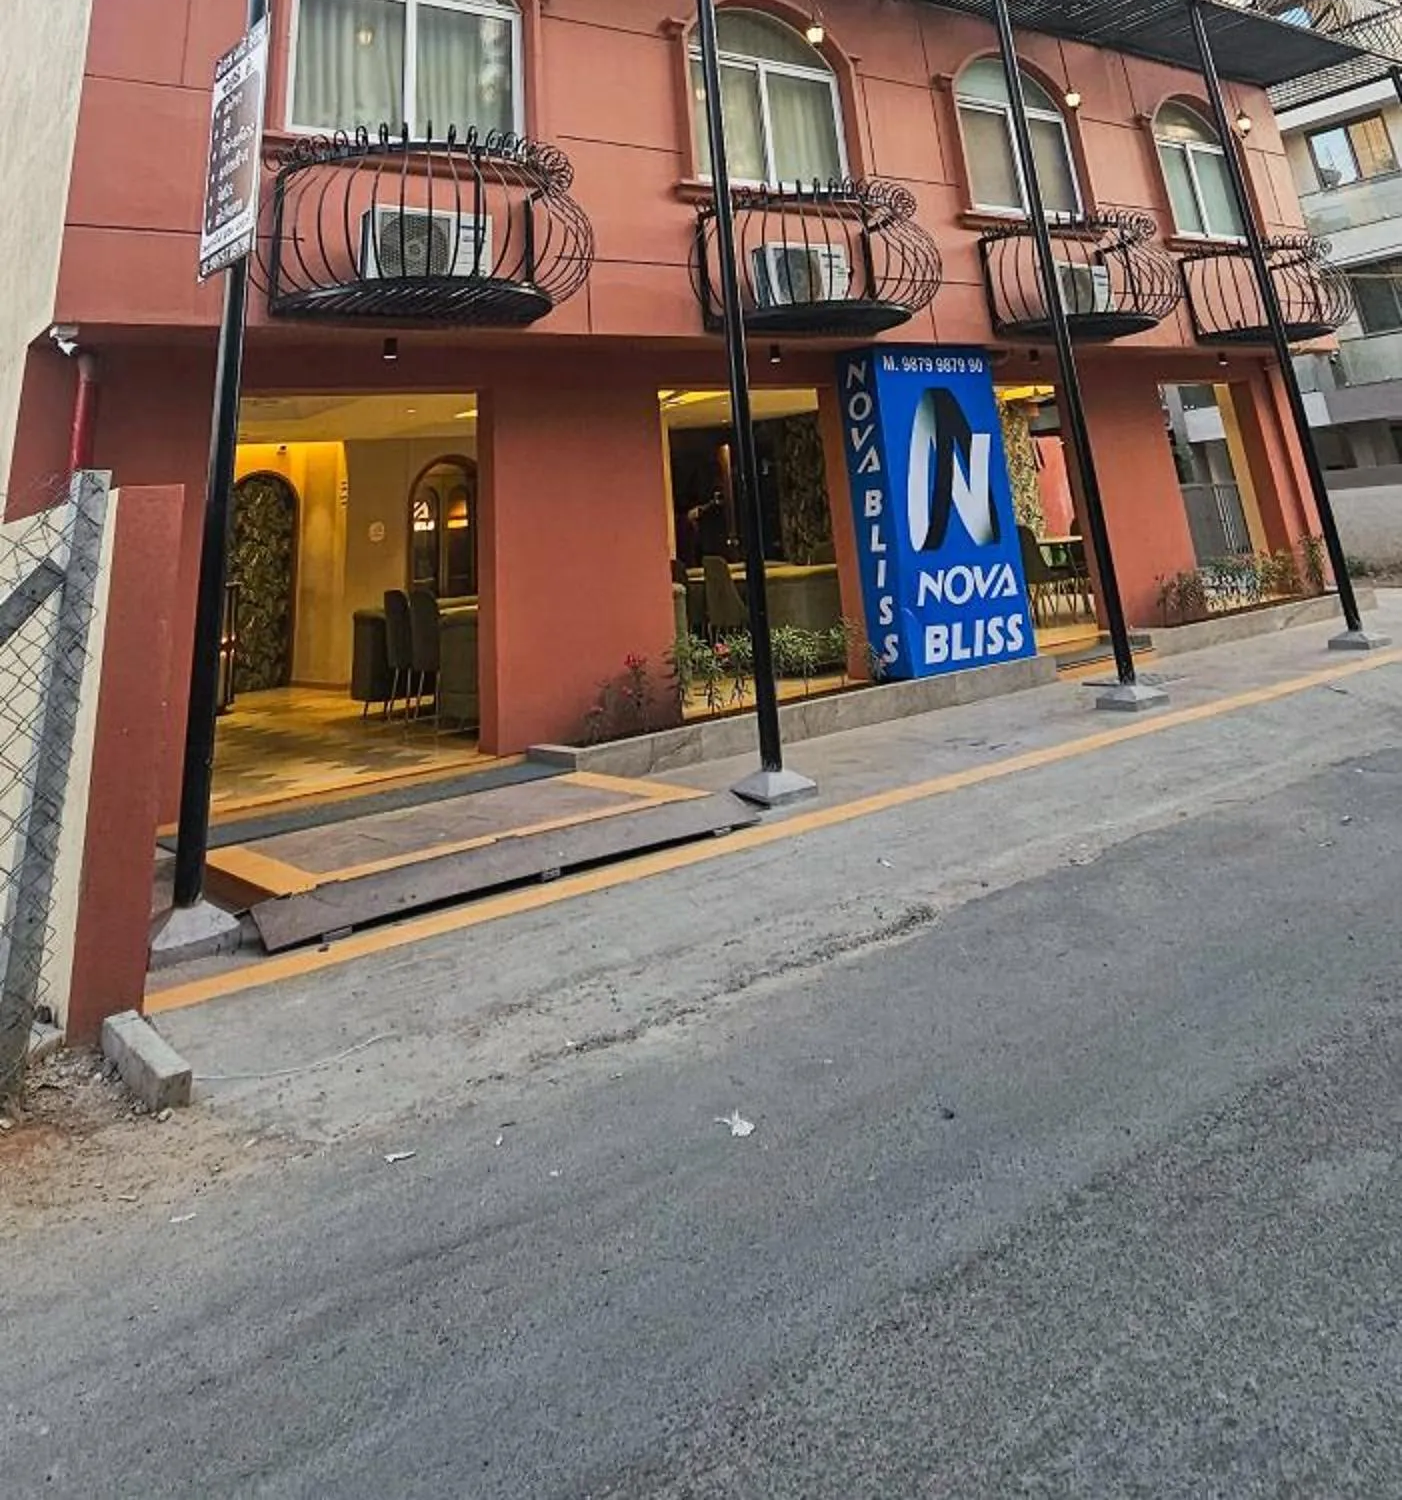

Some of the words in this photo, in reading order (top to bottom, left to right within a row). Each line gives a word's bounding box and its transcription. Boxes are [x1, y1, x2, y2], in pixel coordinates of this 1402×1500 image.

[883, 356, 898, 371] M.
[902, 356, 932, 372] 9879
[936, 357, 965, 373] 9879
[968, 358, 983, 373] 90
[846, 357, 881, 474] NOVA
[865, 489, 899, 663] BLISS
[917, 564, 1018, 606] NOVA
[925, 614, 1024, 664] BLISS
